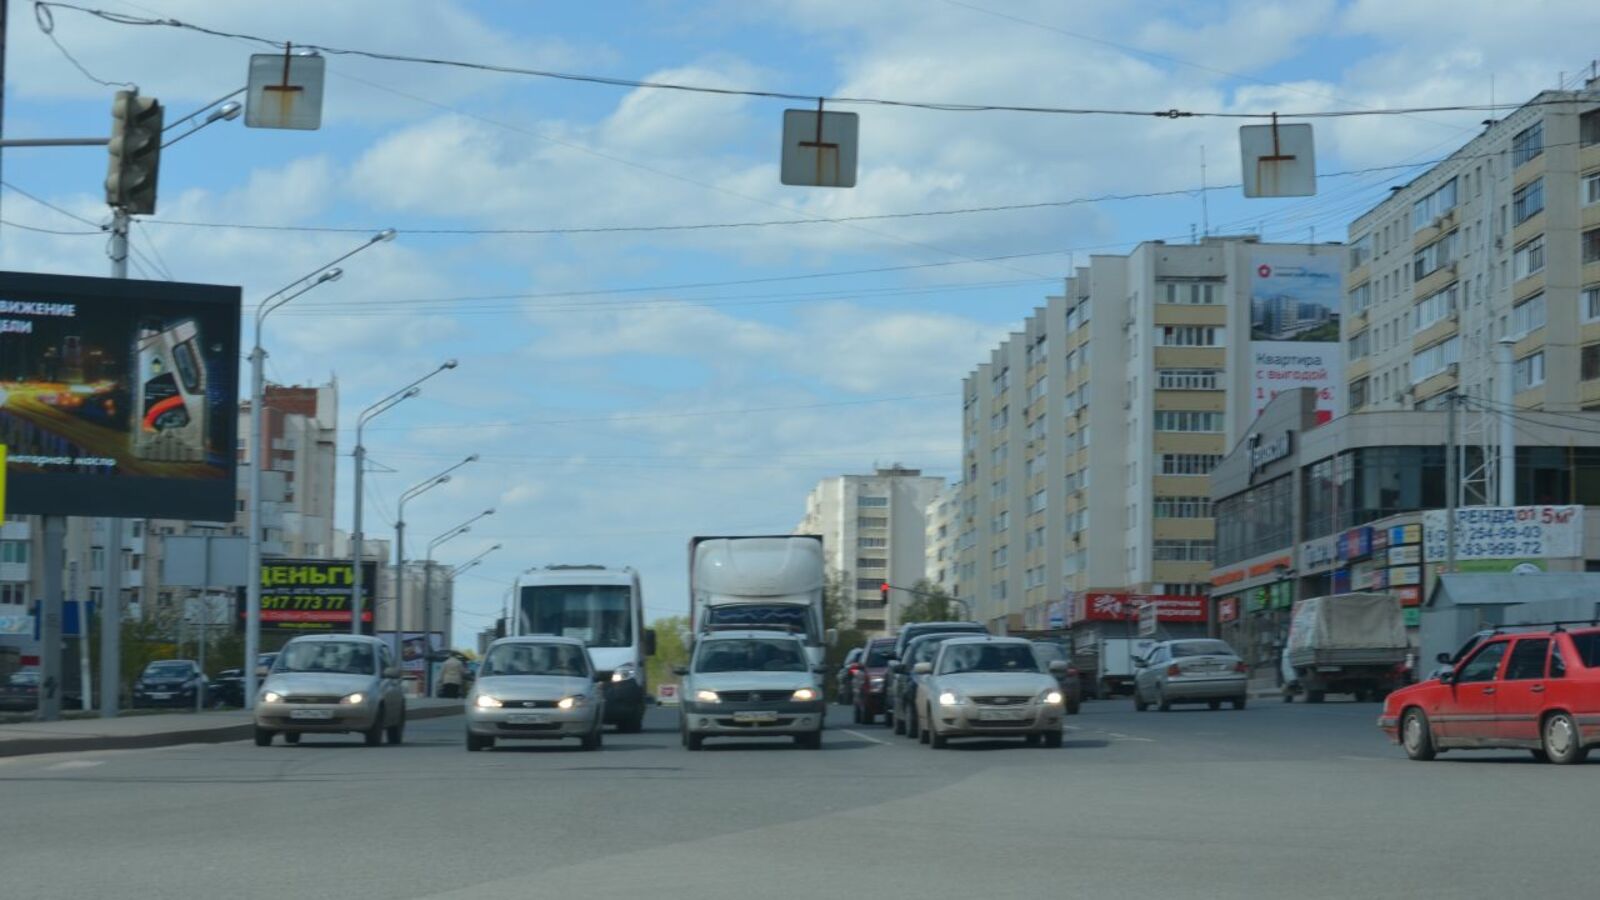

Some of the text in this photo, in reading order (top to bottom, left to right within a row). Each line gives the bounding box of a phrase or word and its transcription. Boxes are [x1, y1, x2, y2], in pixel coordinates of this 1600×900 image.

[1256, 353, 1322, 367] Квартира
[1267, 368, 1328, 382] выгодой
[293, 595, 322, 609] 773
